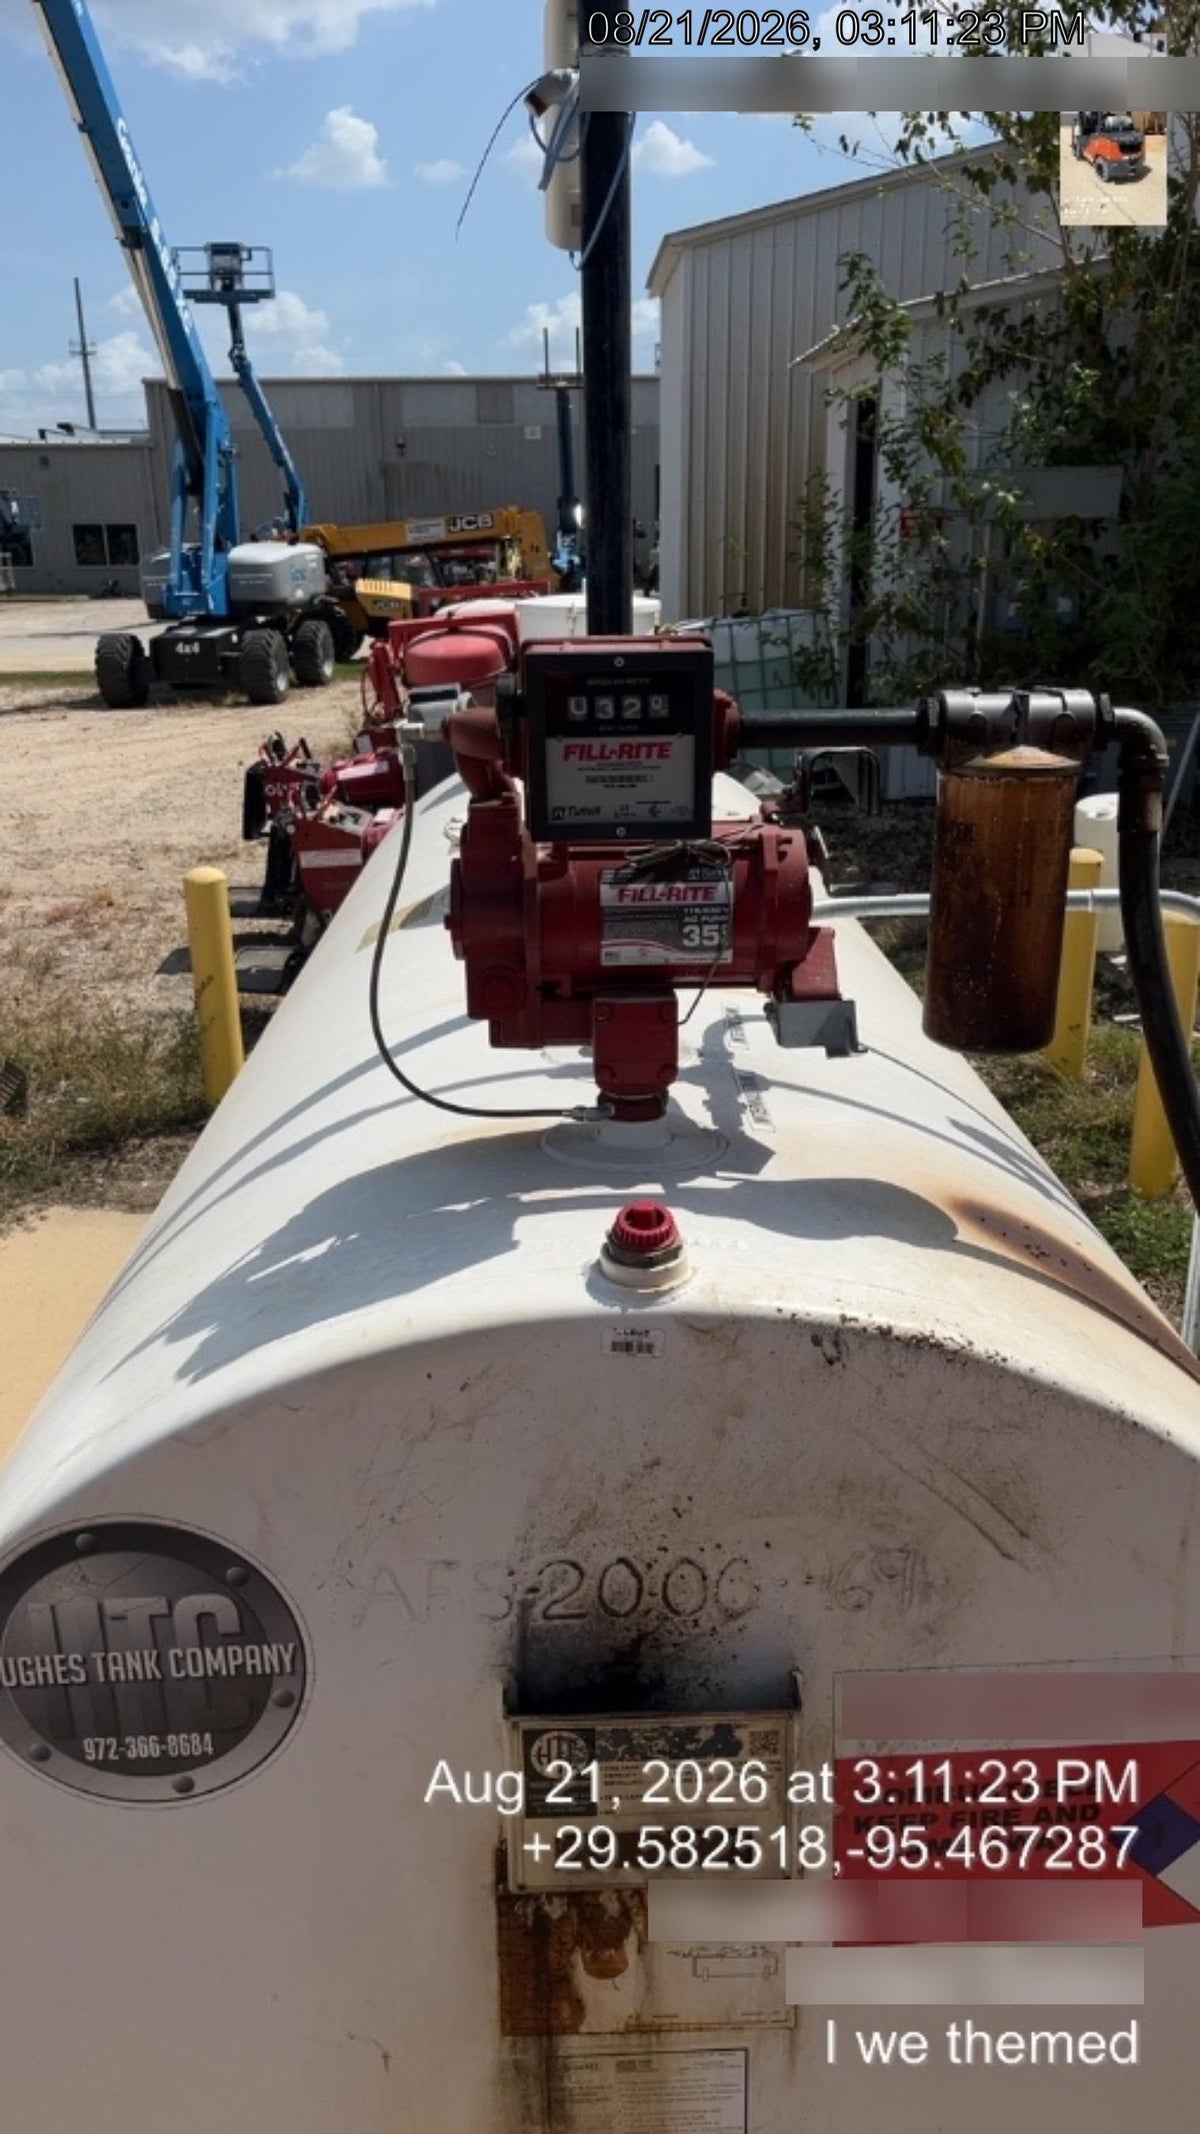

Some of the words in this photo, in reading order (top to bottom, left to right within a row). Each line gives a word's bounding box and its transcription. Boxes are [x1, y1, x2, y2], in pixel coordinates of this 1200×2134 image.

[450, 515, 492, 532] JCB
[175, 642, 200, 654] 4x4
[563, 741, 673, 762] FILL-RITE
[617, 885, 718, 904] FILL-RITE
[681, 924, 720, 947] 35
[0, 1653, 86, 1688] UGHES
[91, 1649, 163, 1682] TANK
[168, 1641, 296, 1679] COMPANY
[83, 1732, 215, 1762] 972-366-8684
[950, 1808, 1021, 1831] FIRE
[1033, 1803, 1099, 1825] AND
